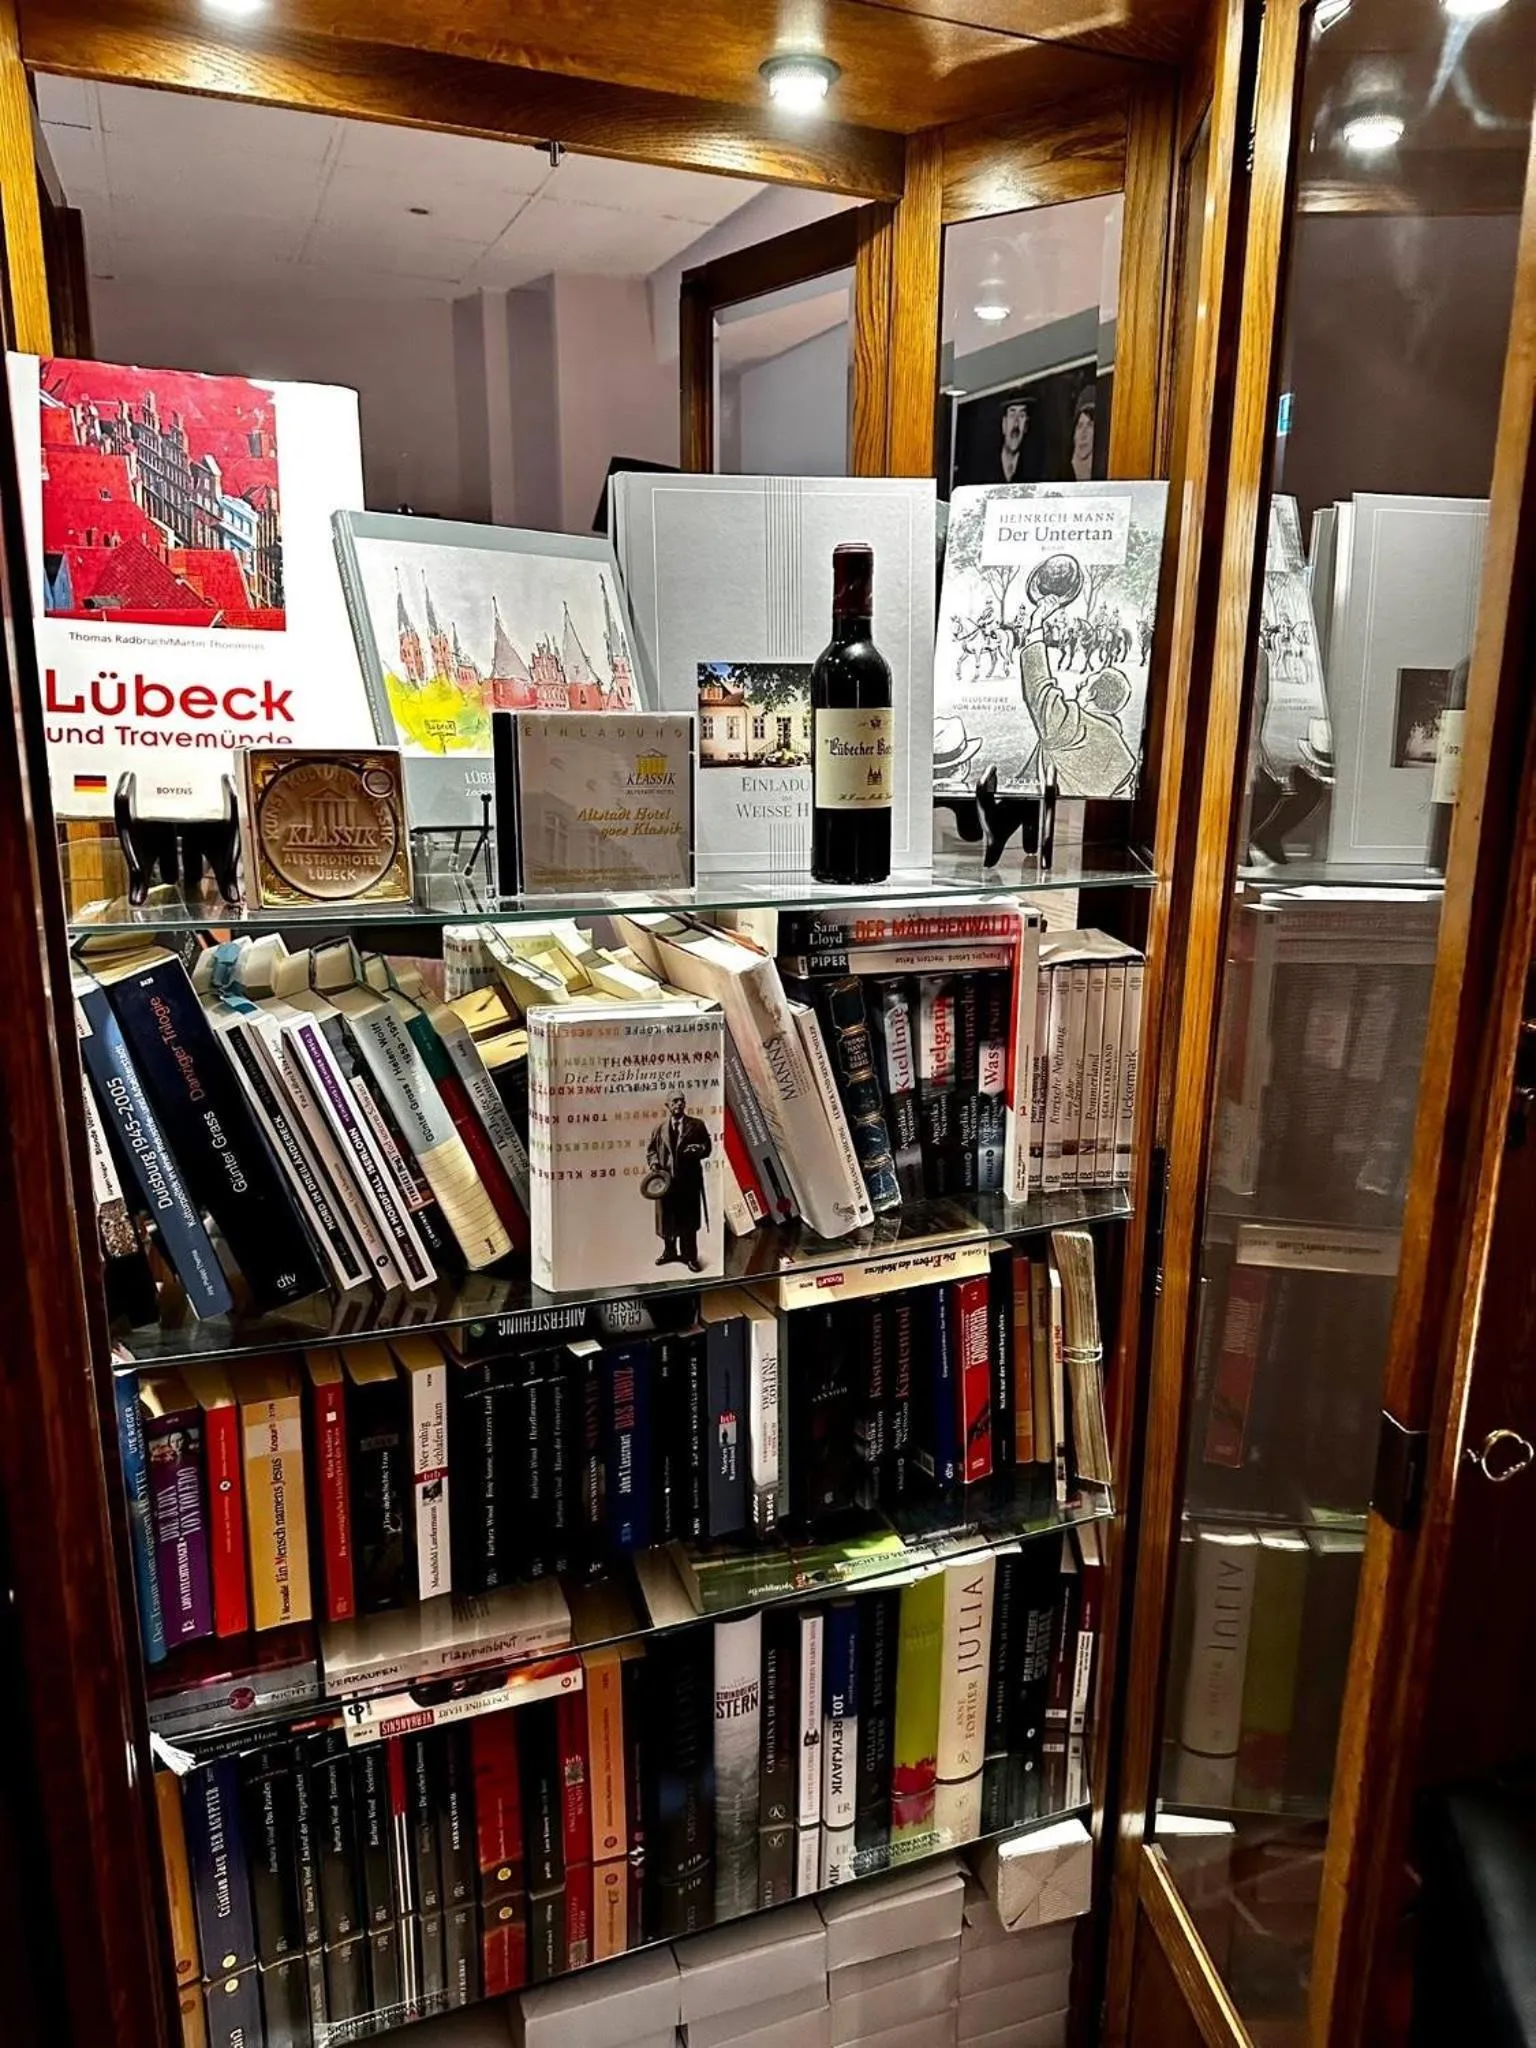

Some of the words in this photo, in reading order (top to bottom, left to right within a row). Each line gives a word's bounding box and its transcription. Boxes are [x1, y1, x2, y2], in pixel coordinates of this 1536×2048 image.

[1000, 512, 1067, 524] HEINRICH
[1073, 512, 1116, 522] MANN
[998, 527, 1029, 542] Der
[1036, 527, 1113, 541] Untertan
[68, 631, 112, 645] Thomas
[45, 669, 294, 722] Lübeck
[46, 726, 104, 745] und
[524, 726, 683, 737] EINLADUNG
[156, 786, 193, 796] BOYENS
[626, 773, 678, 786] KLASSIK
[741, 776, 810, 793] EINLADU
[736, 803, 792, 818] WEISSE
[286, 824, 379, 846] KLASSIK
[633, 823, 683, 836] Klassik
[309, 867, 357, 881] LÜBECK
[809, 932, 843, 947] Lloyd
[813, 920, 839, 933] Sam
[854, 919, 888, 941] DER
[893, 914, 1012, 938] MÄDCHENWALD
[810, 955, 848, 968] PIPER
[145, 994, 181, 1044] Trilogie
[370, 1020, 390, 1048] Wolff
[930, 995, 951, 1087] Kielgang
[382, 1046, 404, 1076] Helen
[890, 1007, 911, 1093] Kiellinie
[1050, 1026, 1066, 1074] Nehrung
[167, 1041, 209, 1103] Danziger
[564, 1072, 588, 1084] Die
[594, 1068, 681, 1082] Erzählungen
[761, 1035, 800, 1103] MANNS
[1102, 1044, 1113, 1119] SCHATTENLAND
[400, 1082, 421, 1112] Grass
[1085, 1053, 1099, 1120] Pommerland
[1121, 1050, 1137, 1119] Uckermark
[412, 1110, 436, 1144] Günter
[899, 1108, 909, 1150] Angelika
[905, 1099, 915, 1141] Svensson
[932, 1103, 942, 1145] Angelika
[939, 1094, 948, 1137] Svensson
[960, 1105, 970, 1147] Angelika
[968, 1095, 977, 1140] Svensson
[980, 1105, 991, 1146] Angelika
[199, 1109, 230, 1151] Grass
[271, 1113, 318, 1193] DREILÄNDERECK
[347, 1126, 378, 1176] ISERLOHN
[135, 1149, 179, 1211] Duisburg
[216, 1148, 250, 1195] Günter
[590, 1168, 616, 1177] DER
[309, 1190, 323, 1204] IM
[370, 1175, 401, 1226] MORDFALL
[316, 1204, 336, 1232] MORD
[394, 1224, 407, 1239] IM
[912, 1255, 942, 1267] Erben
[943, 1252, 956, 1260] Die
[608, 1315, 643, 1330] CRAIG
[971, 1305, 987, 1364] GOMORRHA
[434, 1403, 444, 1426] kann
[615, 1406, 634, 1430] DAS
[419, 1421, 430, 1448] ruhig
[434, 1428, 445, 1465] schlafen
[271, 1458, 285, 1486] Jesus
[419, 1450, 429, 1470] Wer
[176, 1466, 198, 1510] TOLEDO
[274, 1487, 286, 1526] namens
[159, 1519, 178, 1542] DIE
[274, 1528, 288, 1565] Mensch
[277, 1566, 289, 1582] Ein
[957, 1575, 984, 1674] JULIA
[328, 1666, 399, 1688] VERKAUFEN
[438, 1704, 462, 1719] HART
[715, 1690, 759, 1719] STERN
[832, 1694, 843, 1717] 101
[966, 1680, 978, 1740] FORTIER
[379, 1711, 433, 1735] VERHÄNGNIS
[832, 1720, 842, 1795] REYKJAVIK
[210, 1832, 224, 1853] DER
